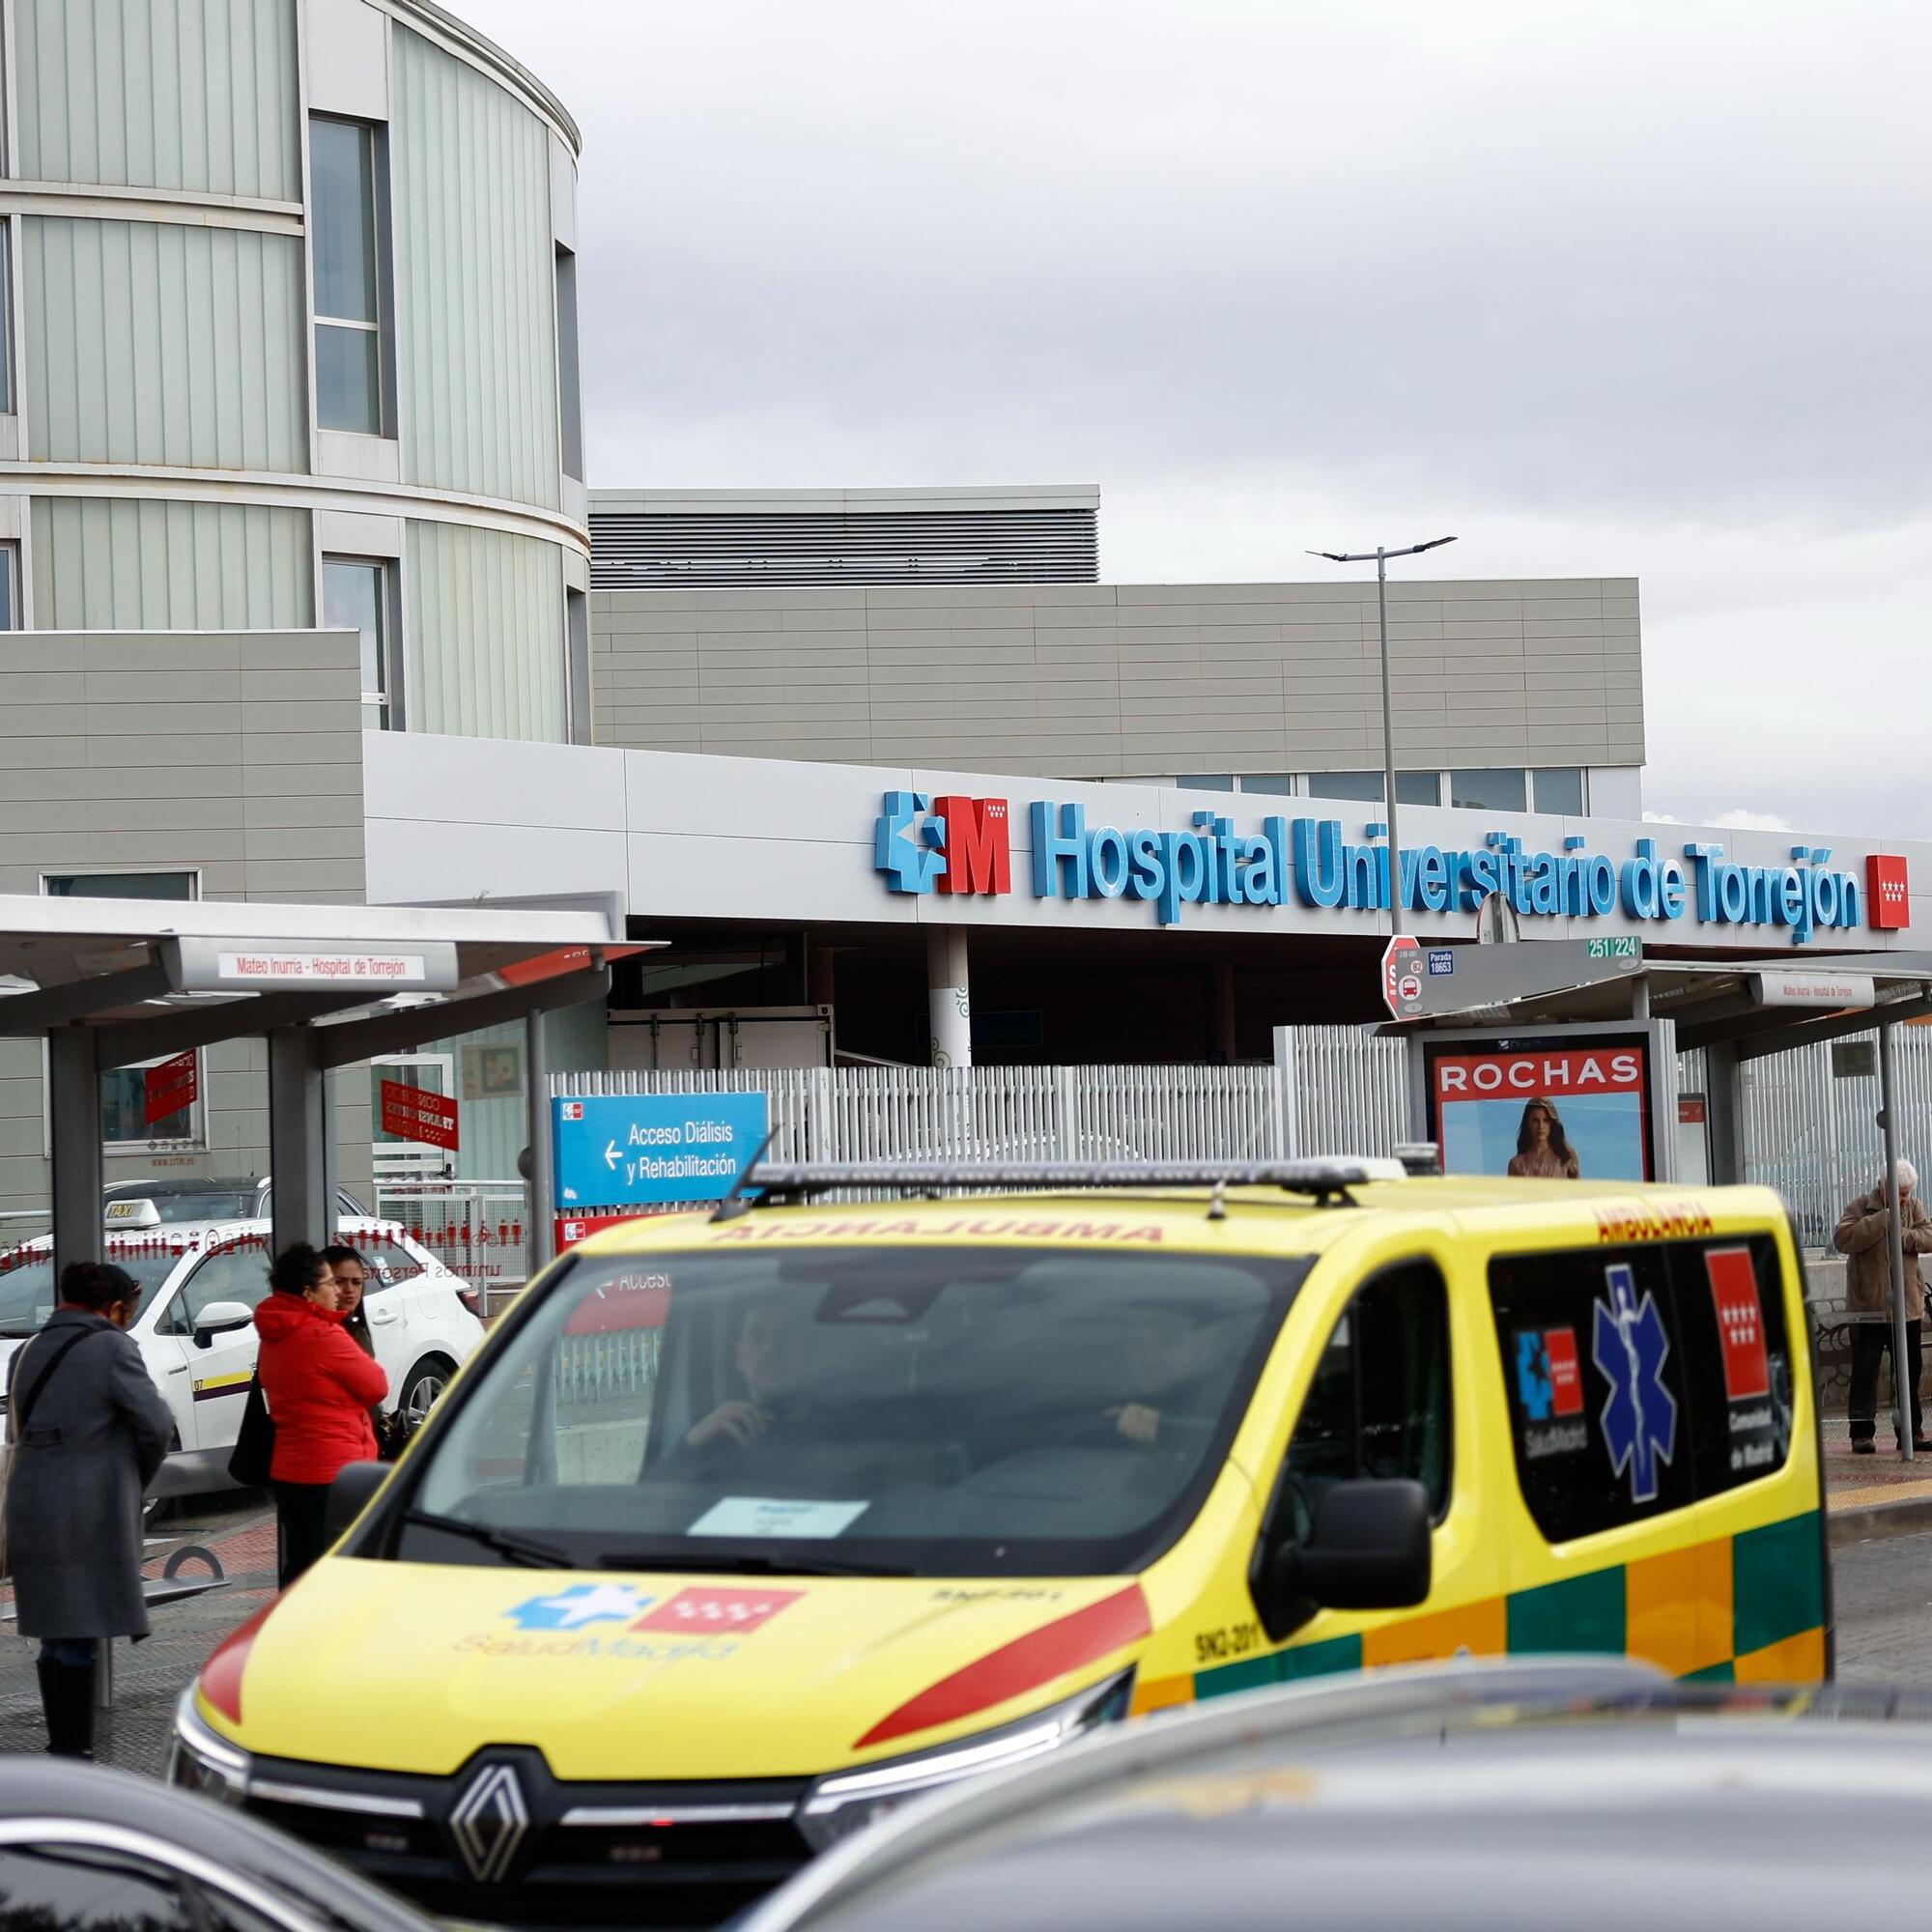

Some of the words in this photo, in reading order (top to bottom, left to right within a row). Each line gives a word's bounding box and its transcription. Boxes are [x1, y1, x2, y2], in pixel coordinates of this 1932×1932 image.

[1031, 800, 1288, 924] Hospital
[1292, 817, 1617, 916] Universitario
[1622, 838, 1686, 920] de
[1684, 842, 1861, 944] Torrejón
[1430, 952, 1452, 962] Parada
[1589, 939, 1609, 958] 251
[1614, 937, 1636, 956] 224
[237, 957, 269, 975] Mateo
[270, 957, 303, 975] Inurria
[311, 957, 352, 979] Hospital
[355, 958, 367, 975] de
[367, 958, 406, 980] Torrejón
[1431, 962, 1452, 974] 18653
[1440, 1055, 1639, 1093] ROCHAS
[629, 1122, 681, 1147] Acceso
[685, 1120, 734, 1144] Diálisis
[626, 1162, 636, 1186] y
[639, 1152, 737, 1179] Rehabilitación
[109, 1205, 133, 1217] TAXI
[1595, 1203, 1715, 1242] AMBULANCIA
